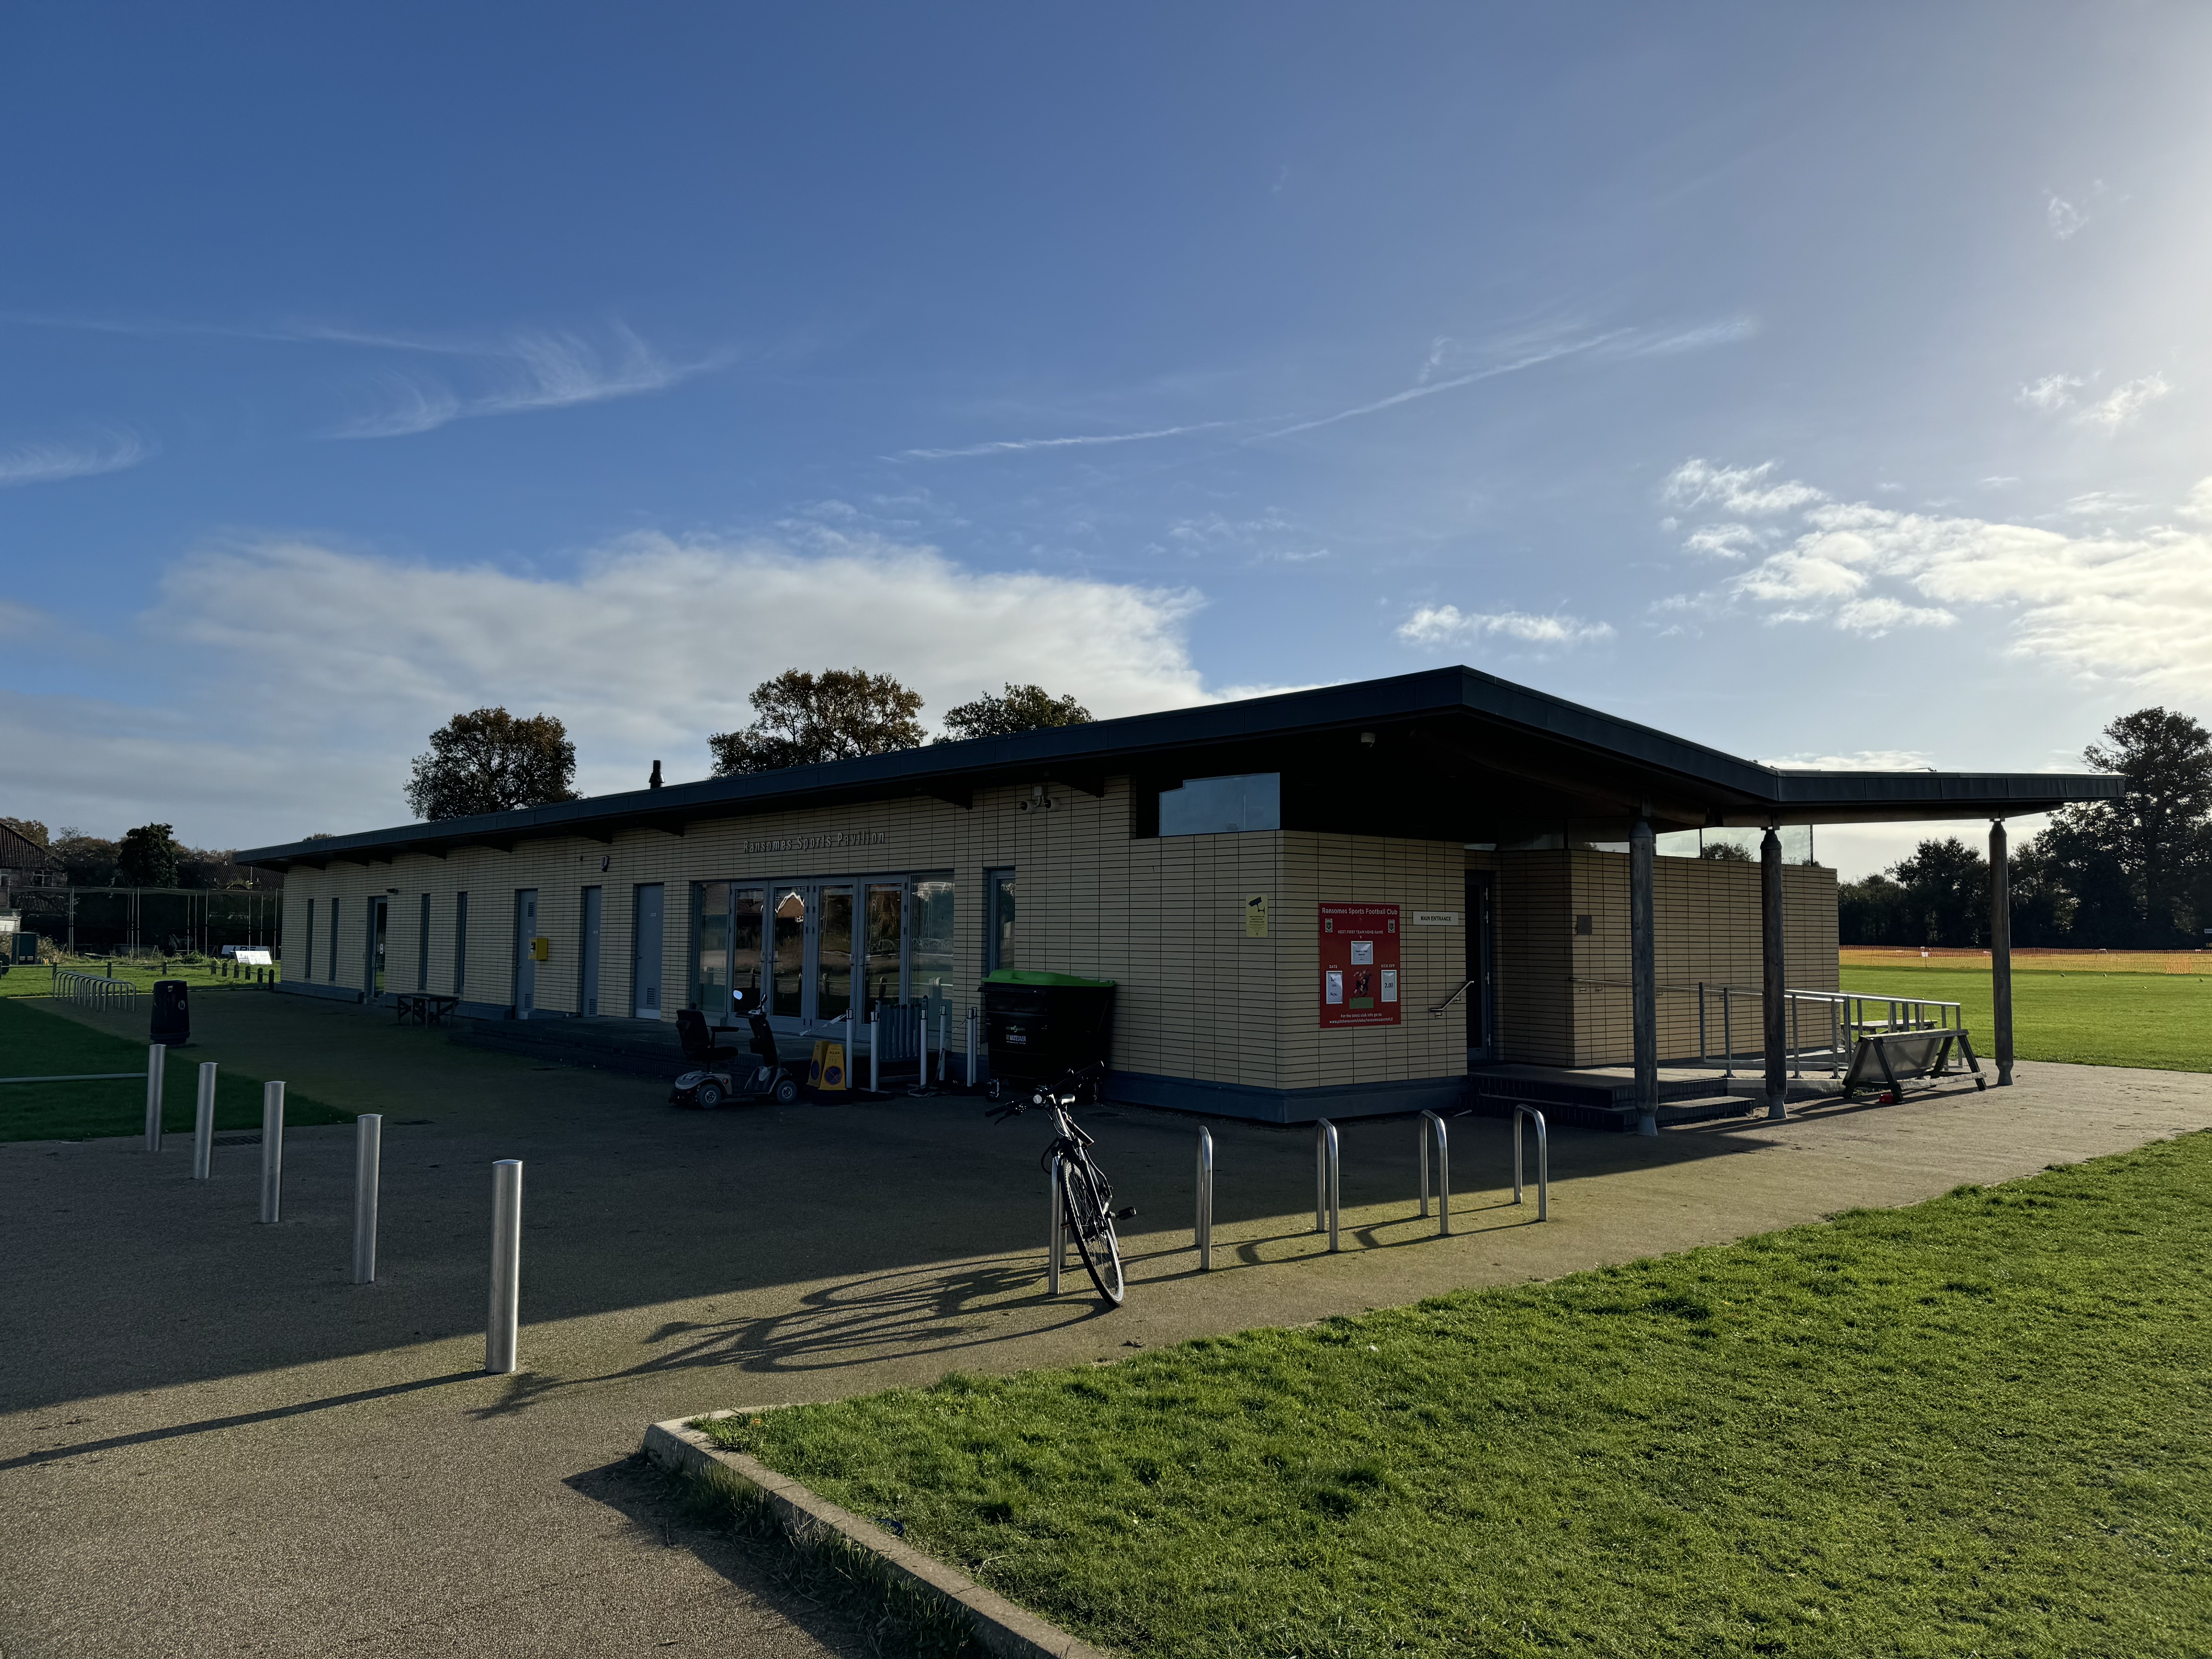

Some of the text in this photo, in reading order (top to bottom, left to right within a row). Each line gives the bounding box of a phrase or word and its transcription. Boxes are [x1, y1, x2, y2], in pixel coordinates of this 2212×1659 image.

[744, 830, 886, 854] Ransomes Sports Pavilion
